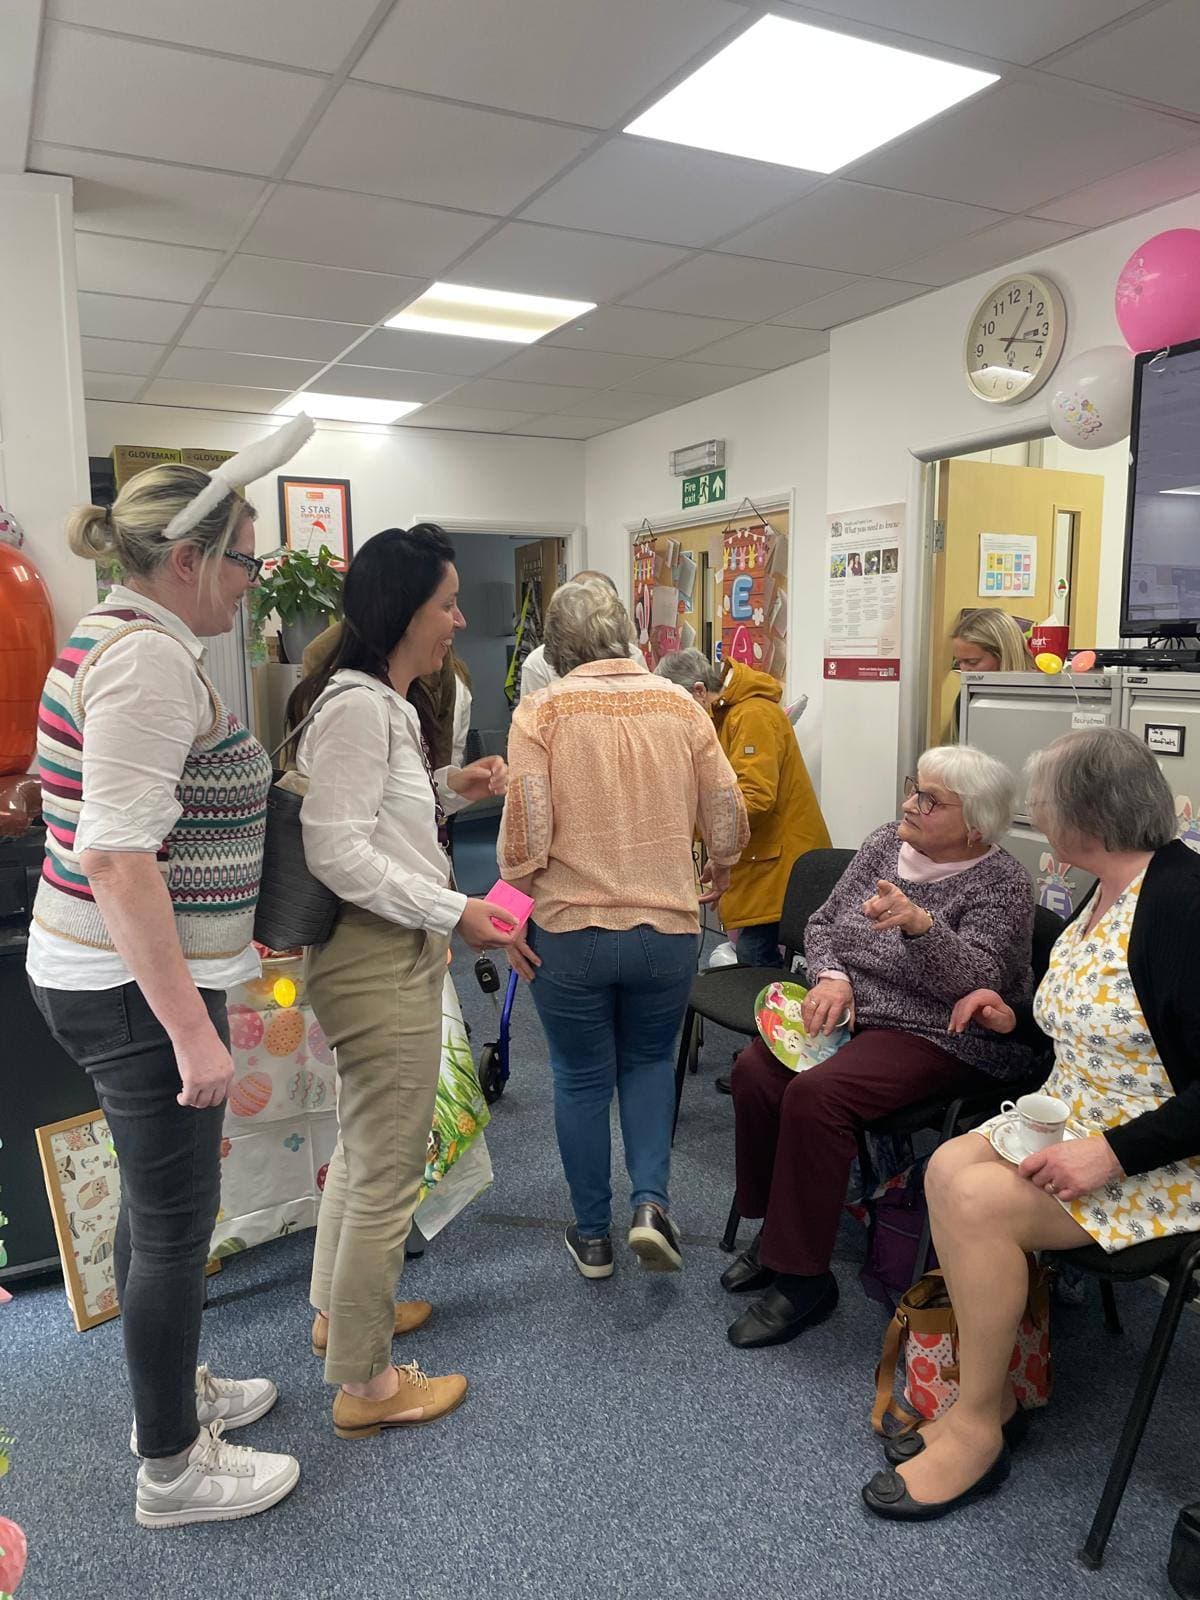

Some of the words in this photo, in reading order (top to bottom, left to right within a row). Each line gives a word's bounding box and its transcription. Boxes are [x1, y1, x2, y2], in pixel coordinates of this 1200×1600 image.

[1008, 289, 1021, 304] 12
[1028, 290, 1033, 304] 1
[993, 301, 1004, 316] 11
[1036, 302, 1044, 316] 2
[982, 321, 995, 336] 10
[1042, 322, 1049, 336] 3
[976, 344, 984, 357] 9
[1035, 345, 1043, 358] 4
[128, 450, 176, 461] GLOVEMAN
[684, 483, 697, 493] Fire
[684, 493, 696, 504] exit
[300, 505, 306, 513] 5
[308, 506, 331, 514] STAR
[845, 526, 857, 534] What
[857, 526, 867, 534] you
[867, 521, 879, 531] need
[732, 575, 753, 621] E
